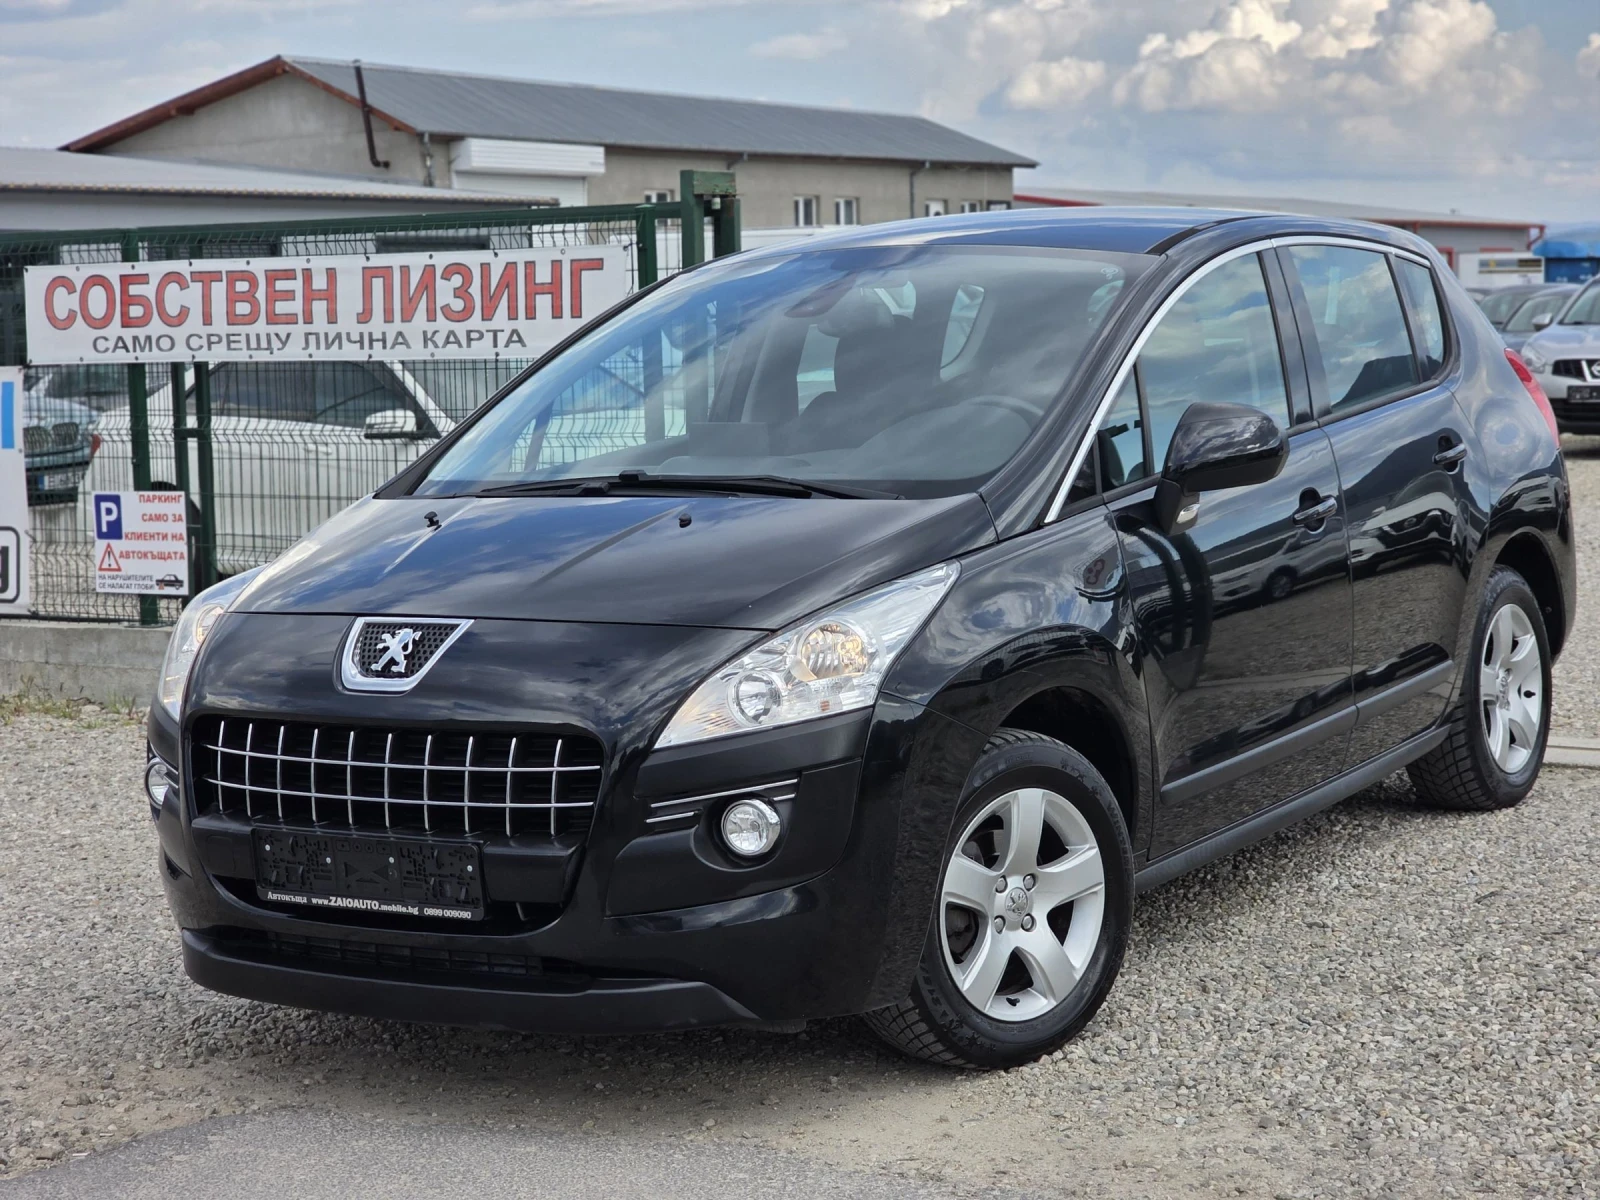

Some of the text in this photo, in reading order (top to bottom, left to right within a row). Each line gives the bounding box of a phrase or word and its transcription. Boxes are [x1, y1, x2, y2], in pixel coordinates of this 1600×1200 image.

[44, 257, 604, 331] СОБСТВЕН ЛИЗИНГ
[92, 328, 527, 354] САМО СРЕЩУ ЛИЧНА КАРТА
[138, 494, 182, 504] ПАРКИНГ
[100, 502, 118, 532] P
[141, 513, 184, 523] САМО ЗА
[124, 532, 185, 542] КЛИЕНТИ НА
[119, 550, 185, 561] АВТОКЪЩАТА
[267, 891, 308, 905] Автокъща
